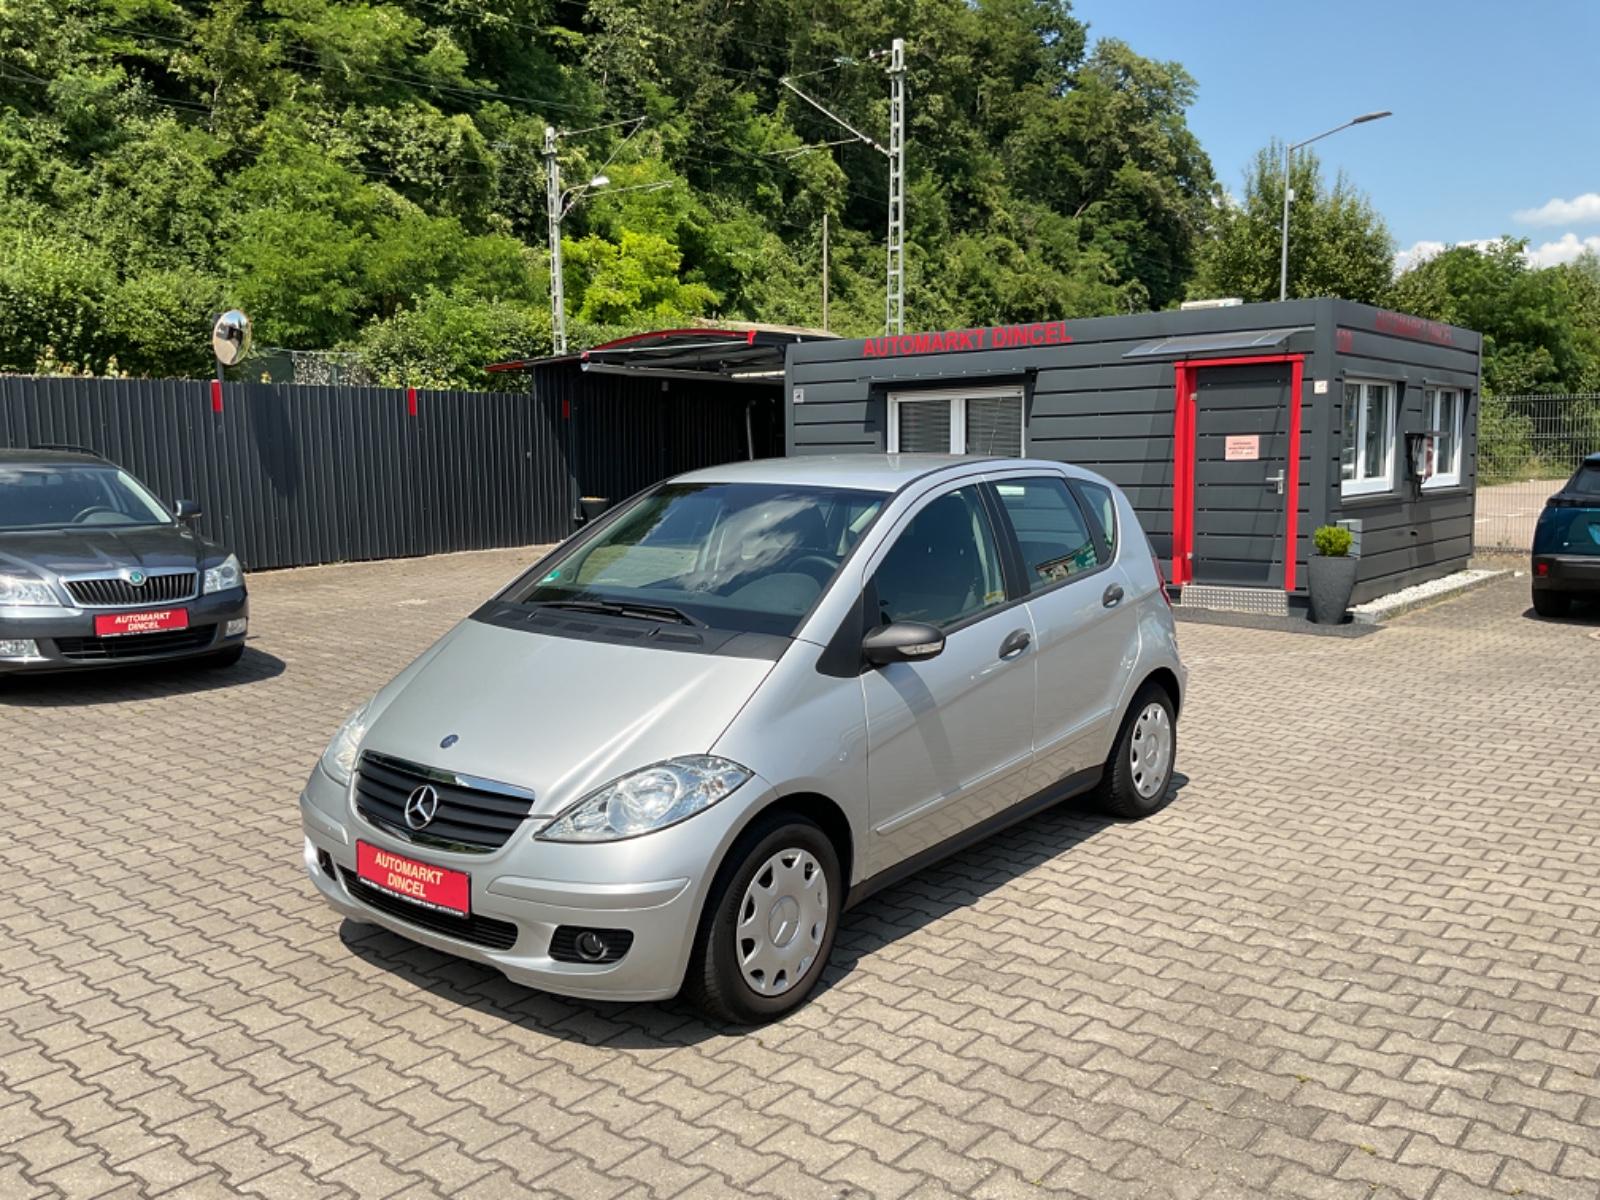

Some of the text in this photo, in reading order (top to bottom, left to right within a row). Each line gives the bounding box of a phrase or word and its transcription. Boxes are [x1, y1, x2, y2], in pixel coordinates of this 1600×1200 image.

[863, 320, 1073, 358] AUTOMARKT DINCEL
[115, 612, 171, 624] AUTOMARKT
[128, 621, 160, 631] DINCEL
[375, 852, 443, 885] AUTOMARKT
[387, 873, 427, 899] DINCEL
